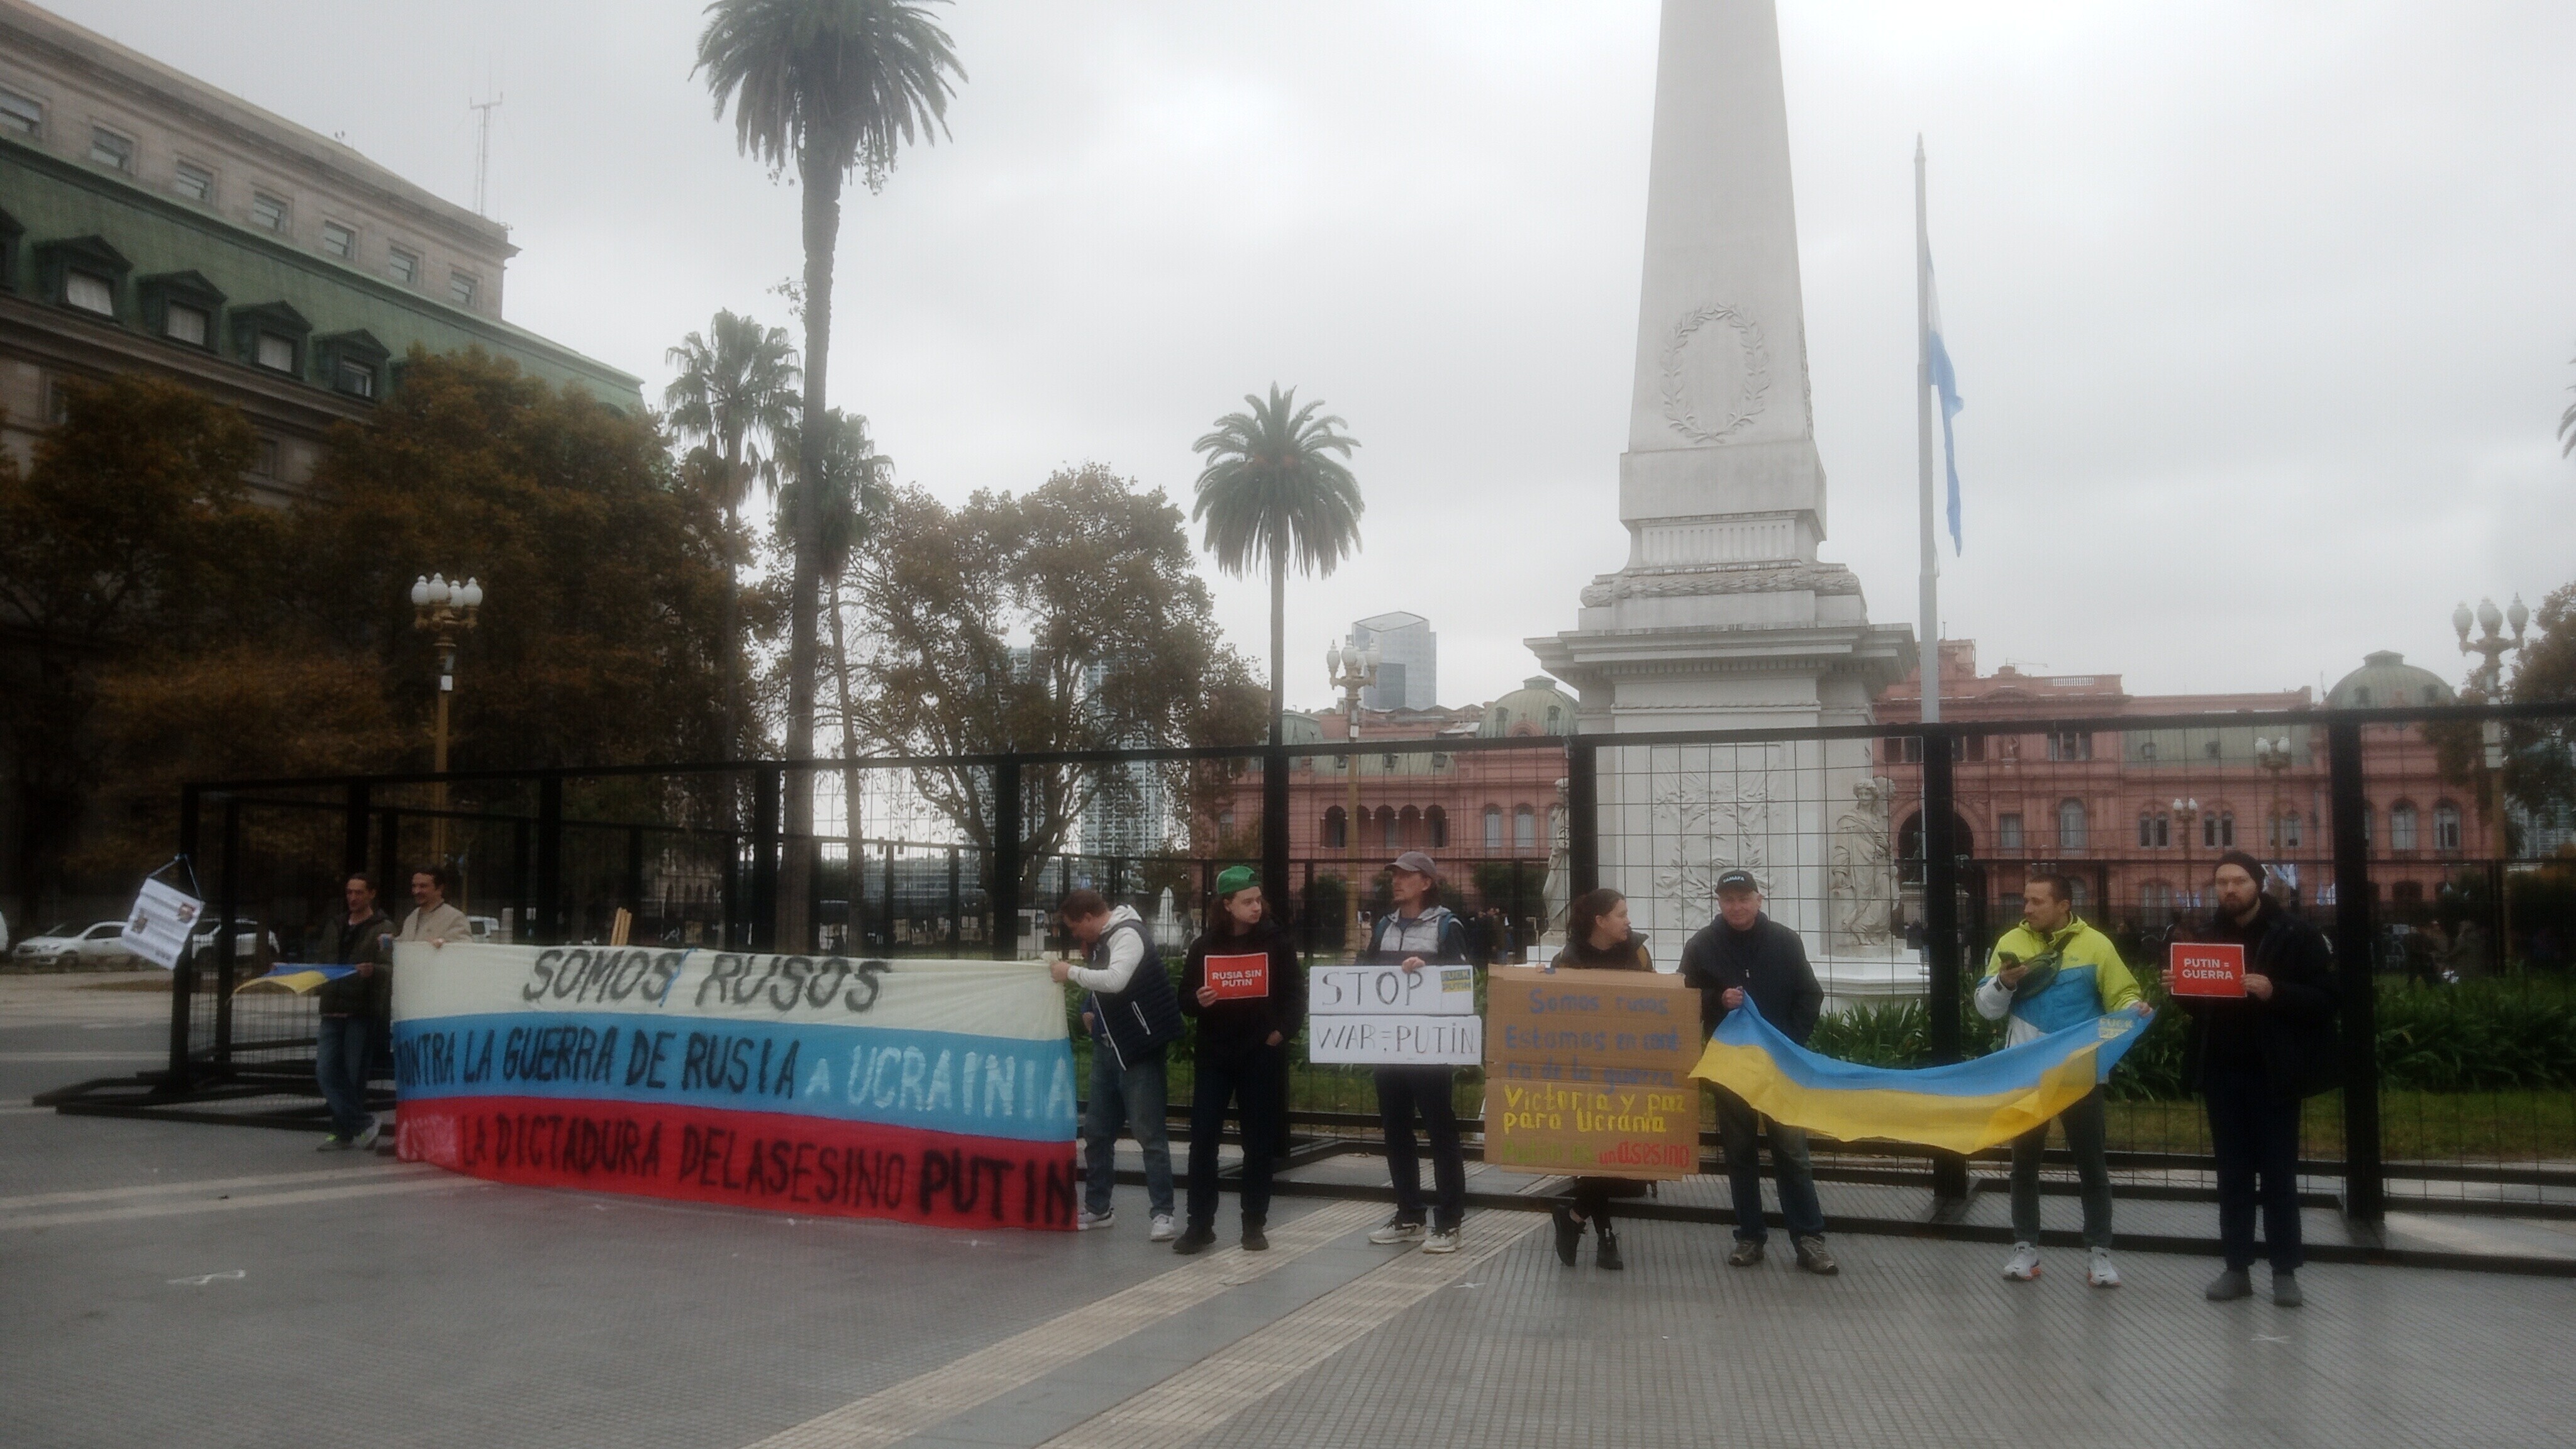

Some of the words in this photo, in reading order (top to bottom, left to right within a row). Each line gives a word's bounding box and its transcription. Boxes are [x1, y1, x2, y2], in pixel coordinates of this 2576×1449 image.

[1211, 971, 1243, 980] RUSIA
[1245, 969, 1262, 978] SIN
[2182, 969, 2234, 980] GUERRA
[2183, 958, 2221, 969] PUTIN
[522, 948, 684, 1004] SOMOS
[694, 953, 892, 1013] RUSOS
[1221, 979, 1253, 987] PUTIN
[1321, 970, 1424, 1006] STOP
[1529, 987, 1601, 1014] Somos
[1316, 1024, 1376, 1051] WAR
[1504, 1024, 1607, 1052] Estamos
[1616, 1031, 1636, 1052] en
[463, 1028, 496, 1084] LA
[503, 1024, 619, 1084] GUERRA
[624, 1028, 677, 1090] DE
[680, 1031, 801, 1100] RUSIA
[804, 1057, 831, 1096] A
[847, 1044, 1077, 1120] UCRAINIA
[1504, 1082, 1613, 1112] Victoria
[1619, 1093, 1636, 1114] y
[1646, 1092, 1686, 1118] paz
[1502, 1111, 1562, 1135] para
[1576, 1106, 1668, 1133] Ucrania
[461, 1113, 487, 1168] LA
[496, 1112, 664, 1178] DICTADURA
[918, 1148, 1077, 1226] PUTIN
